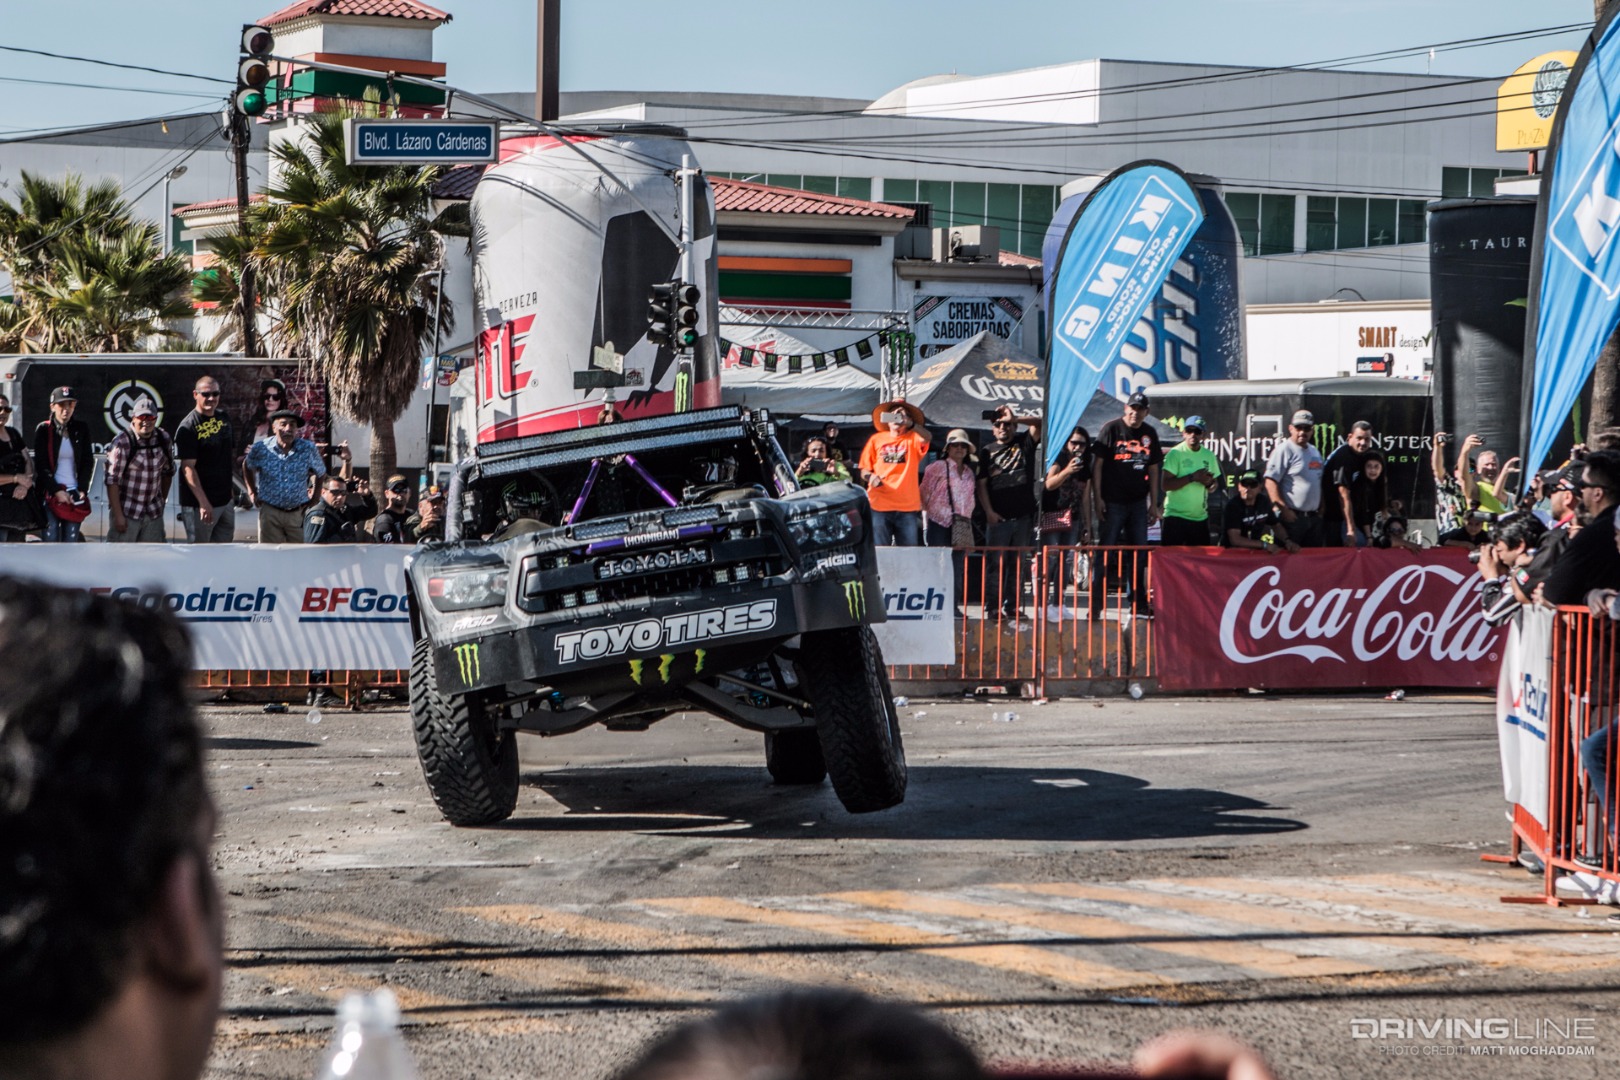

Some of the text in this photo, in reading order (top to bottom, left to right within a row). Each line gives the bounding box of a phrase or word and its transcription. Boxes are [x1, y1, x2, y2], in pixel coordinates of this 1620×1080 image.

[364, 132, 488, 151] Blvd. Lázaro Cárdenas
[948, 302, 995, 320] CREMAS
[1358, 326, 1423, 352] SMART design
[1387, 455, 1420, 463] RGY
[604, 547, 702, 576] TOYOTA
[817, 553, 857, 569] RIGID
[250, 614, 273, 623] Tires
[923, 612, 942, 621] Tires
[1219, 564, 1499, 664] Coca-Cola
[554, 599, 778, 665] TOYO TIRES
